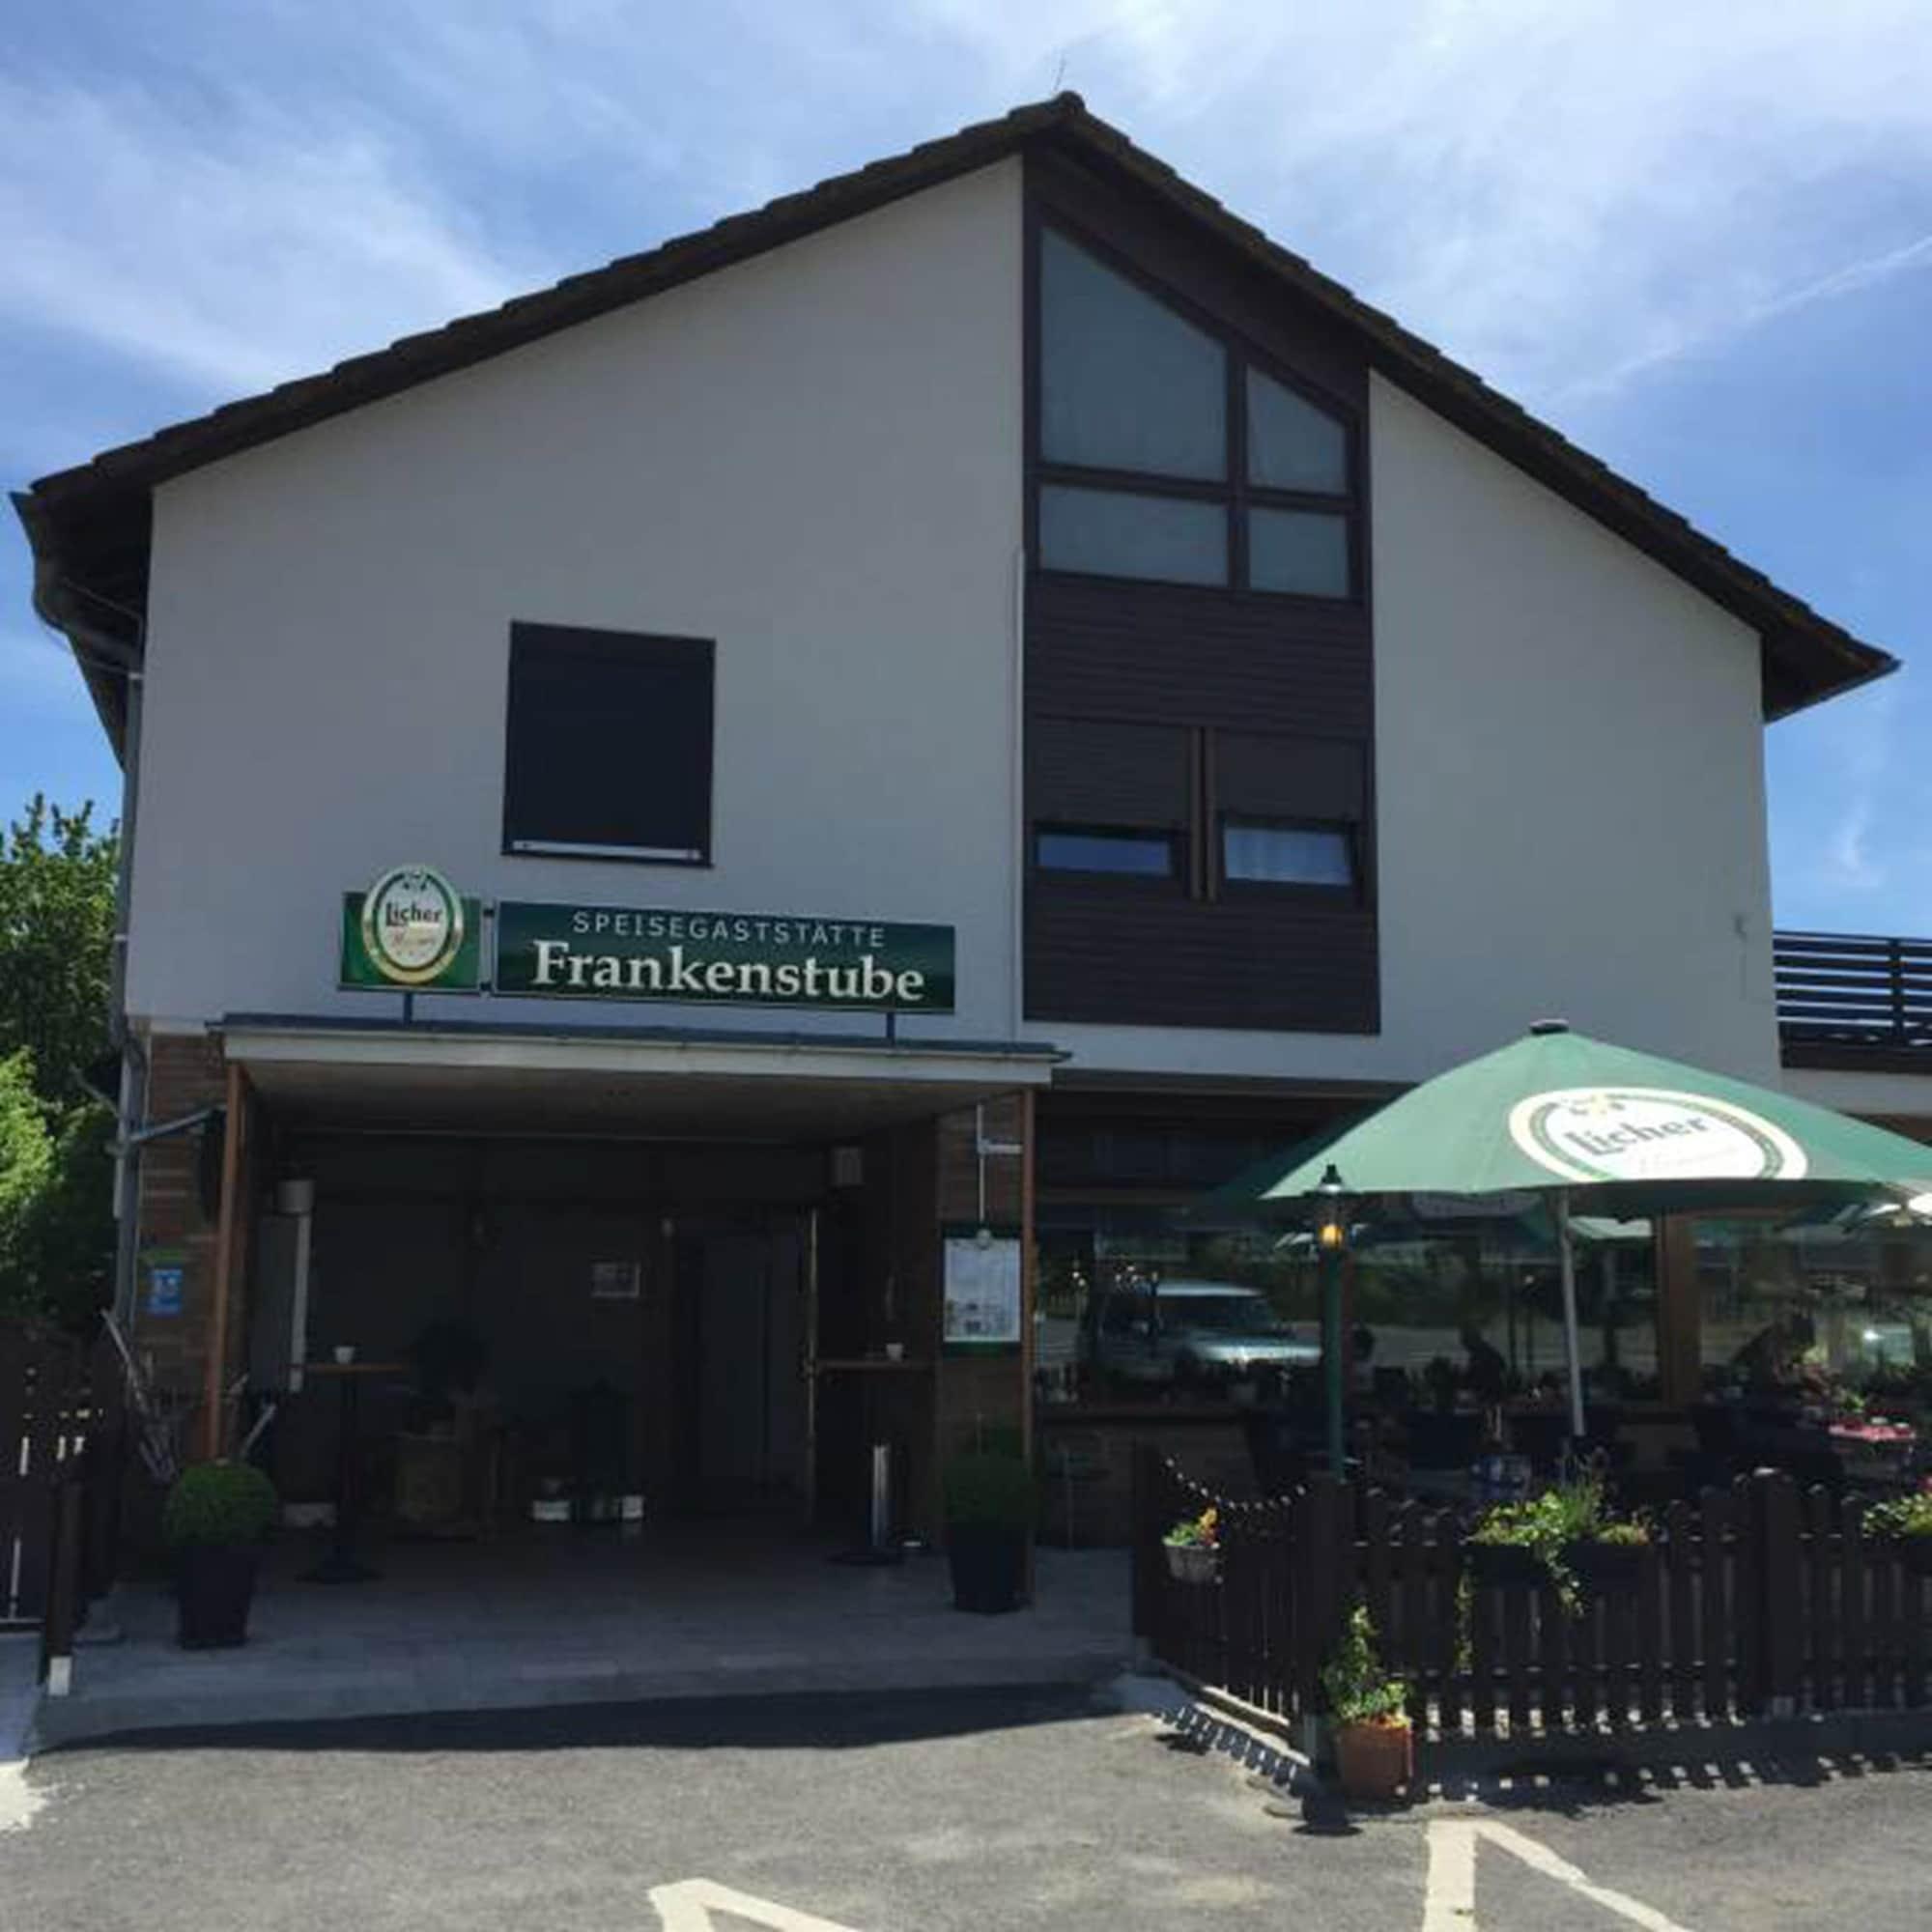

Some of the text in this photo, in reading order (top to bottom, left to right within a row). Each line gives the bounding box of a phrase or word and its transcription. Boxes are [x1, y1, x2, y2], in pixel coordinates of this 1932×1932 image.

[385, 900, 441, 927] Licher
[531, 939, 924, 1001] Frankenstube
[1564, 1117, 1709, 1156] Licher
